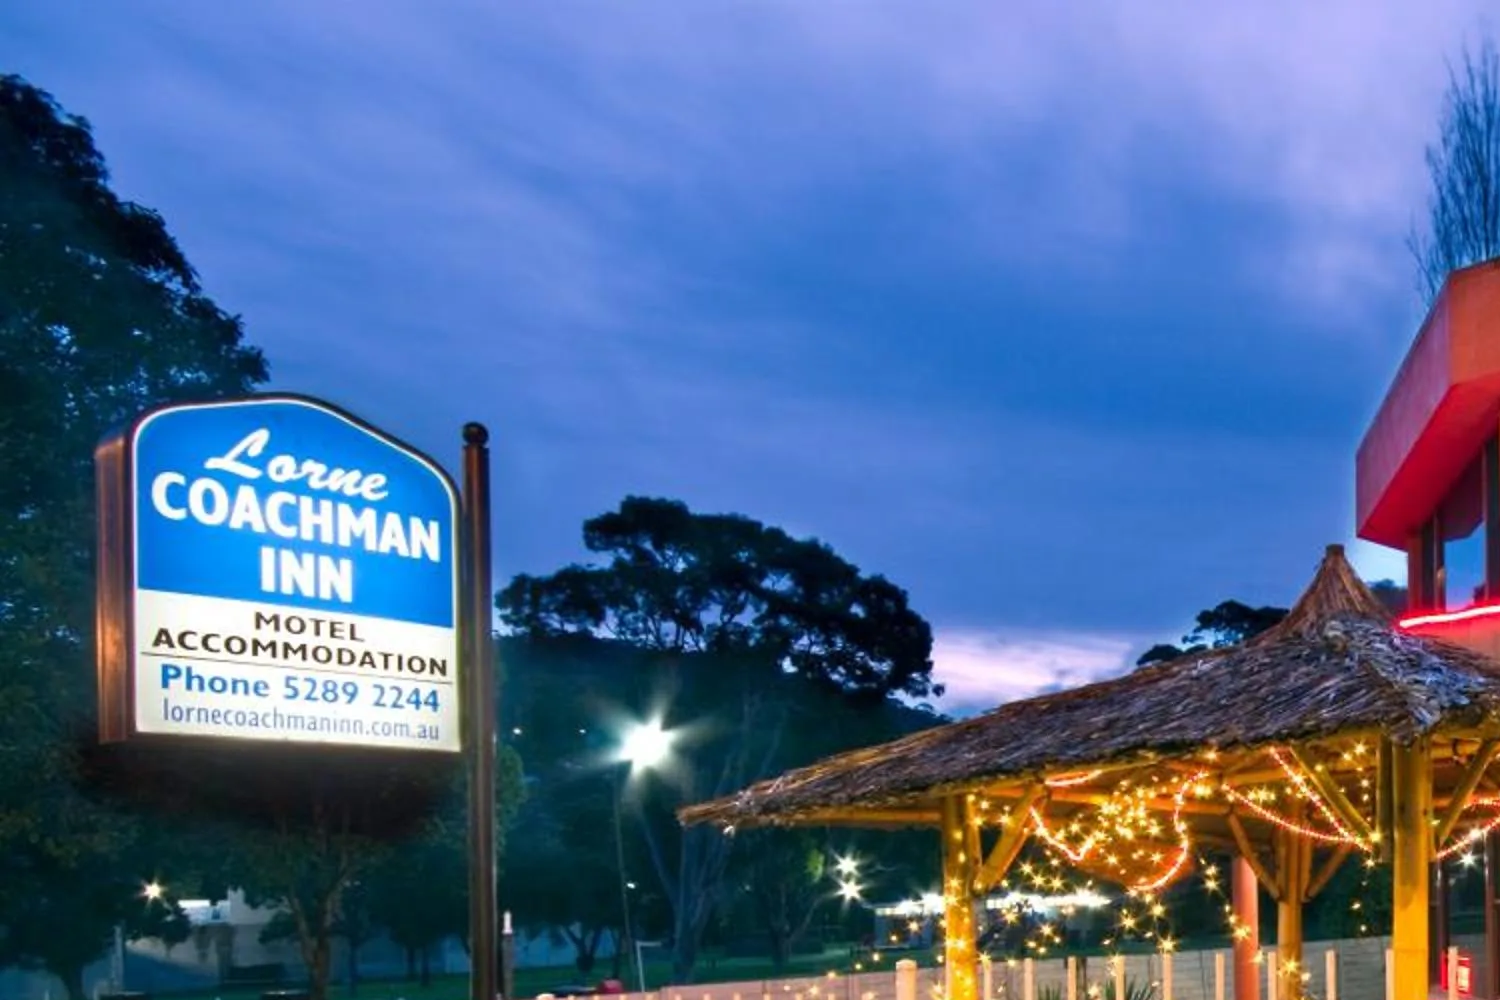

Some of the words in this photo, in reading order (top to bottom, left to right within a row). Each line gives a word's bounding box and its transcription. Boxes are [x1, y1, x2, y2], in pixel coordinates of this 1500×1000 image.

[204, 428, 389, 500] Lorne
[151, 472, 441, 562] COACHMAN
[260, 546, 353, 603] INN
[254, 611, 365, 642] MOTEL
[152, 628, 447, 676] ACCOMMODATION
[160, 663, 270, 698] Phone
[283, 676, 359, 704] 5289
[372, 684, 440, 713] 2244
[162, 698, 440, 740] lornecoachmaninn.com.au
